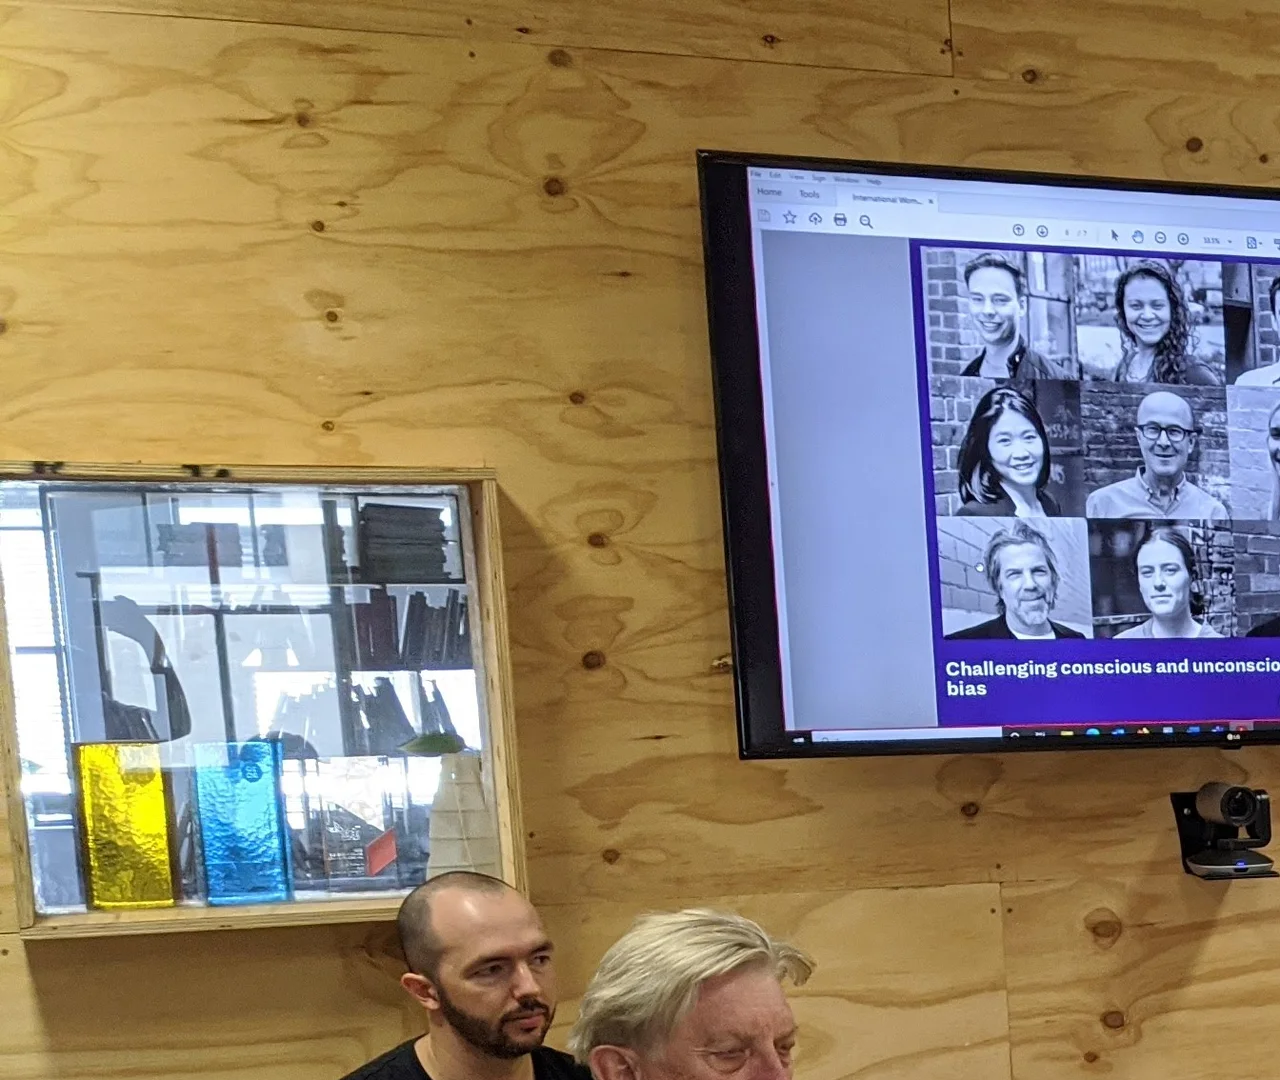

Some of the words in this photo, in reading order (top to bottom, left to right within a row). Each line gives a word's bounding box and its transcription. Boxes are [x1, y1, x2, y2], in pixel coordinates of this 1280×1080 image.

[757, 188, 782, 197] Home
[800, 190, 820, 199] Tools
[946, 660, 1057, 678] Challenging
[1061, 659, 1152, 675] conscious
[1156, 658, 1189, 674] and
[947, 680, 988, 697] bias
